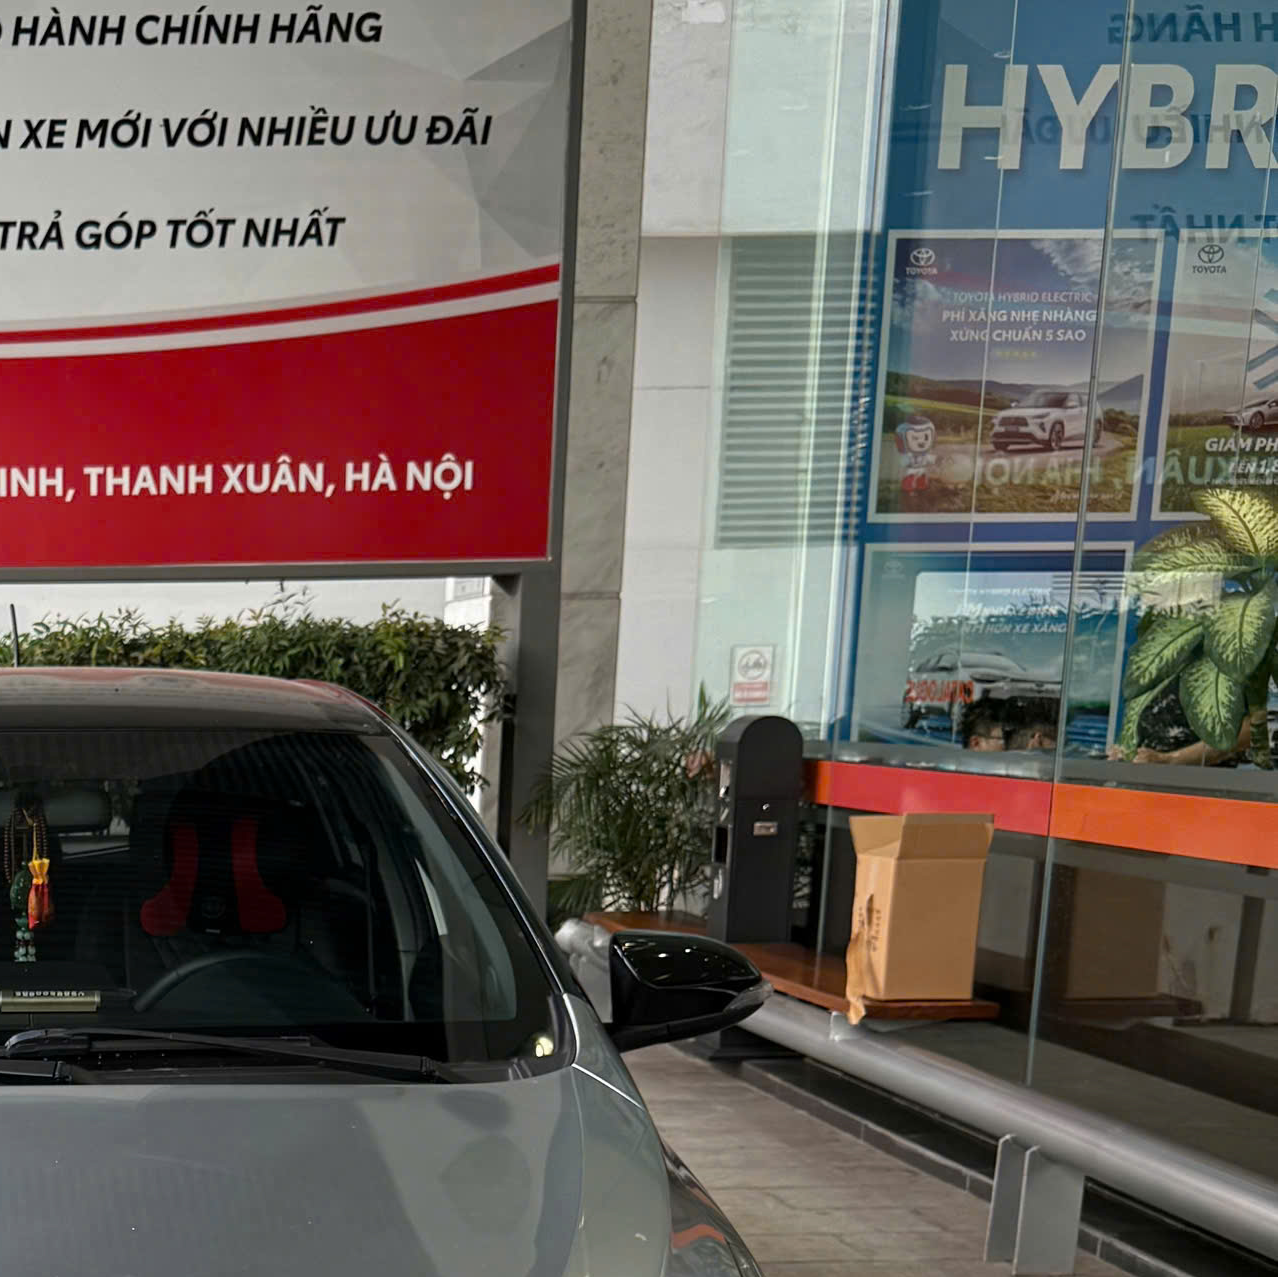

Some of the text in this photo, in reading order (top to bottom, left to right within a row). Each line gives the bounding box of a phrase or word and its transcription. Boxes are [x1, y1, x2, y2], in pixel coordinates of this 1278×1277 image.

[12, 7, 125, 47] HÀNH
[135, 5, 261, 45] CHÍNH
[268, 4, 383, 43] HÃNG
[20, 119, 67, 149] XE
[75, 109, 152, 149] MỚI
[162, 108, 229, 148] VỚI
[237, 105, 356, 147] NHIỀU
[364, 110, 419, 146] ƯU
[425, 107, 492, 145] ĐÃI
[938, 64, 1278, 170] HYBR
[75, 211, 157, 250] GÓP
[166, 208, 236, 249] TỐT
[242, 206, 345, 248] NHẤT
[906, 267, 938, 276] TOYOTA
[1192, 265, 1227, 274] TOYOTA
[953, 291, 1093, 303] TOYOTA HYBRID ELECTRIC
[1009, 310, 1040, 325] NHẸ
[1042, 307, 1097, 321] NHÀNG
[1045, 329, 1053, 341] 5
[1056, 329, 1086, 341] SAO
[83, 464, 213, 497] THANH
[222, 454, 335, 499] XUÂN,
[345, 453, 398, 492] HÀ
[405, 453, 473, 500] NỘI
